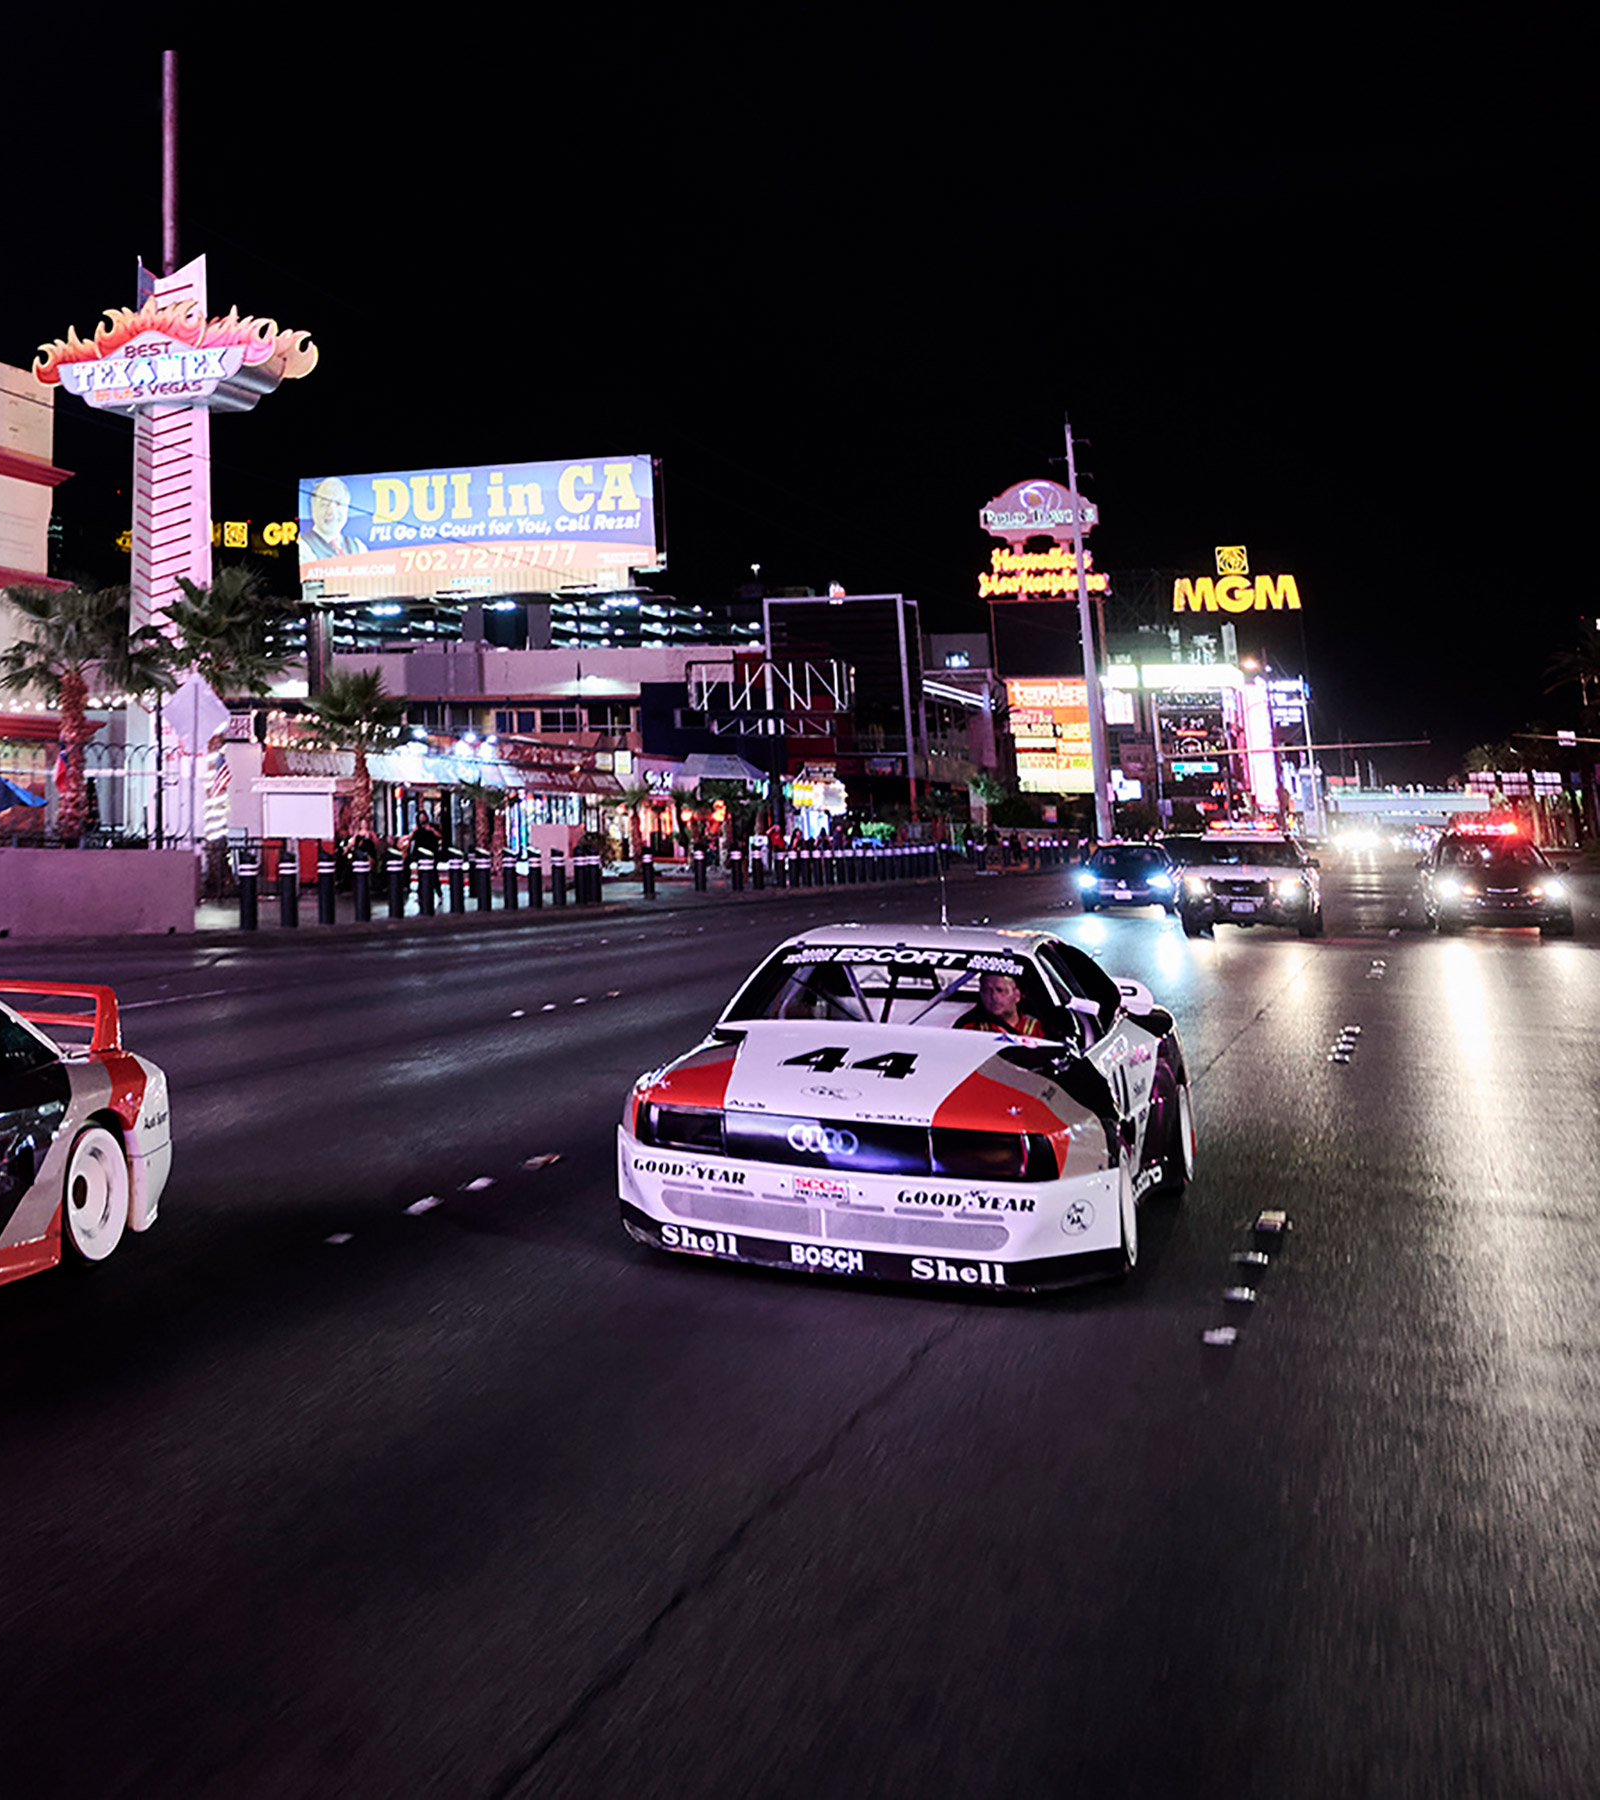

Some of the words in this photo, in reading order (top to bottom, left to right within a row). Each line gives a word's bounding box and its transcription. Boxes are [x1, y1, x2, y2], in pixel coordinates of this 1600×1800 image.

[124, 341, 172, 358] BEST
[148, 380, 202, 395] VEGAS
[371, 474, 472, 524] DUI
[487, 473, 544, 516] in
[558, 461, 641, 514] CA
[262, 521, 299, 546] GR
[369, 524, 391, 542] I'll
[394, 525, 417, 541] Go
[419, 523, 437, 539] to
[439, 520, 485, 538] Court
[487, 519, 513, 536] for
[516, 516, 552, 536] You,
[554, 513, 591, 532] Call
[594, 510, 641, 530] Reza!
[400, 543, 576, 573] 702.727.7777
[1173, 574, 1301, 614] MGM
[833, 948, 967, 966] ESCORT
[778, 1046, 918, 1080] 44
[633, 1159, 746, 1185] GOODYEAR
[795, 1176, 845, 1193] SCCA
[897, 1188, 1036, 1212] GOODYEAR
[661, 1223, 738, 1255] Shell
[790, 1244, 864, 1272] BOSCH
[911, 1257, 1006, 1286] Shell
